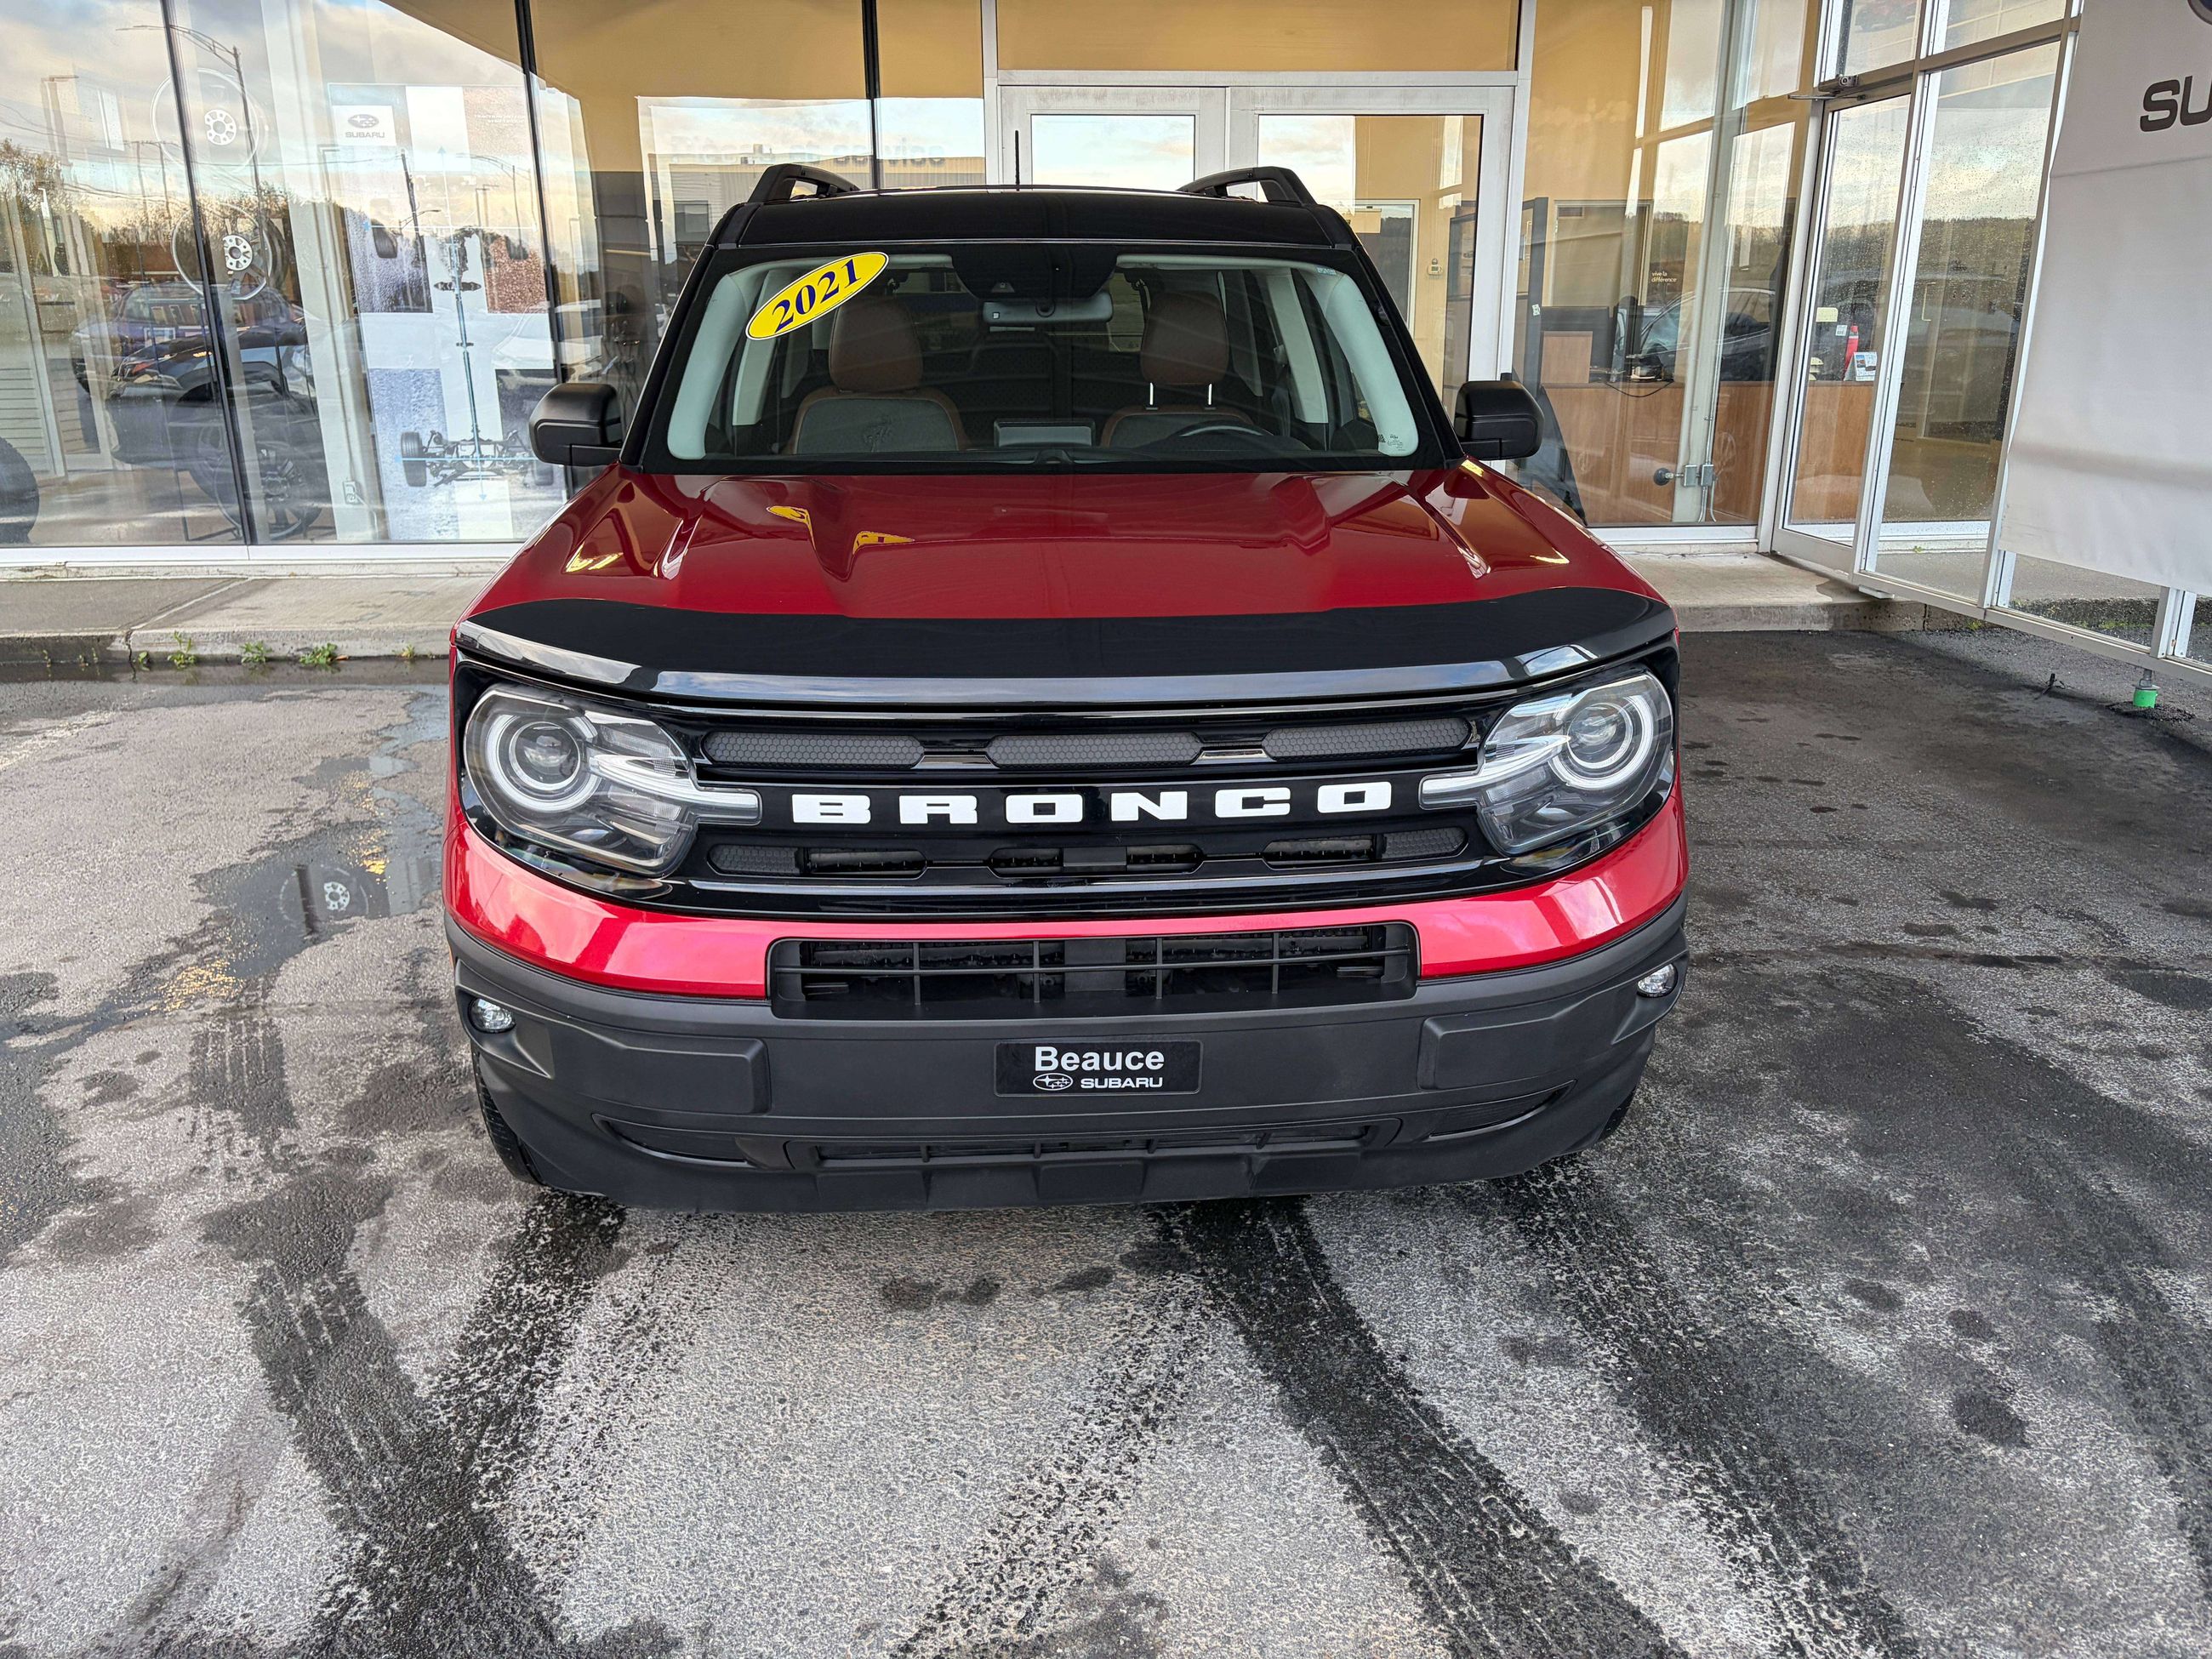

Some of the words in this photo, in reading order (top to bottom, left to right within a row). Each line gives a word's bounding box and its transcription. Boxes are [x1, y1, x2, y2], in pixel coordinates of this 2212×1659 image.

[772, 259, 861, 334] 2021
[791, 781, 1392, 824] BRONCO
[1035, 1046, 1165, 1071] Beauce
[1080, 1077, 1163, 1089] SUBARU
